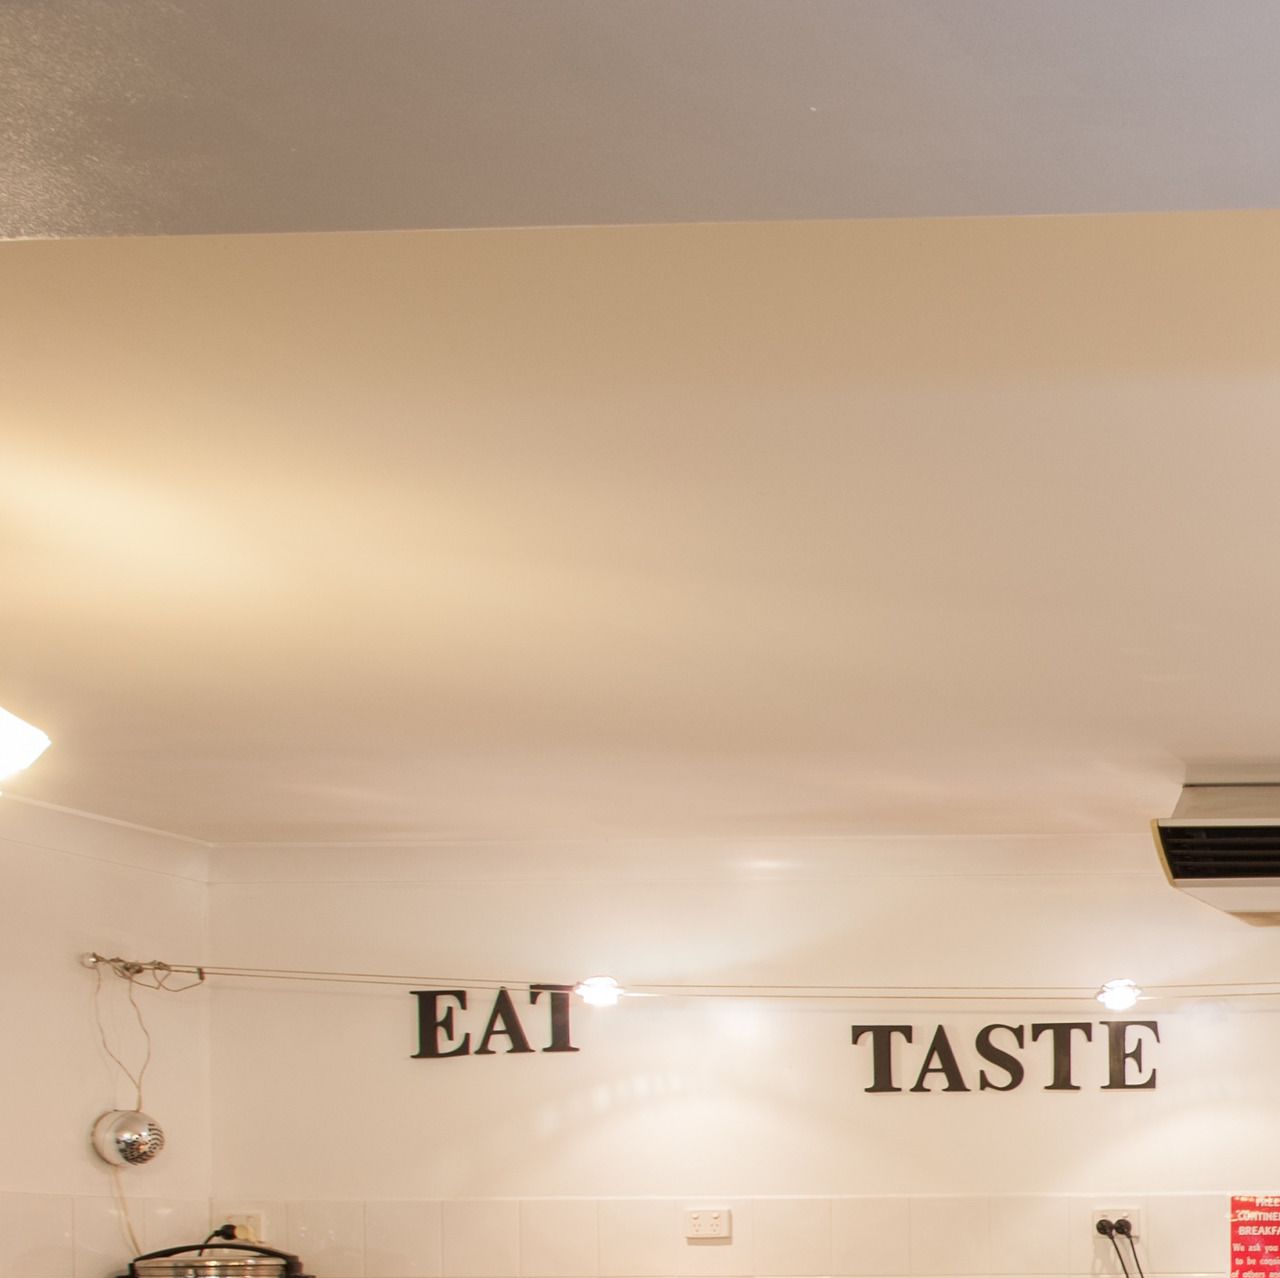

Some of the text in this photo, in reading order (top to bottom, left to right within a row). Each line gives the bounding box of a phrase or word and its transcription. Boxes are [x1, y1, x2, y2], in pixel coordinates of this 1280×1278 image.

[409, 984, 581, 1059] EAT
[851, 1020, 1160, 1093] TASTE
[1232, 1242, 1246, 1252] We
[1248, 1242, 1261, 1252] ask
[1264, 1245, 1279, 1254] you
[1235, 1257, 1244, 1265] to
[1246, 1255, 1257, 1265] be
[1231, 1269, 1240, 1278] of
